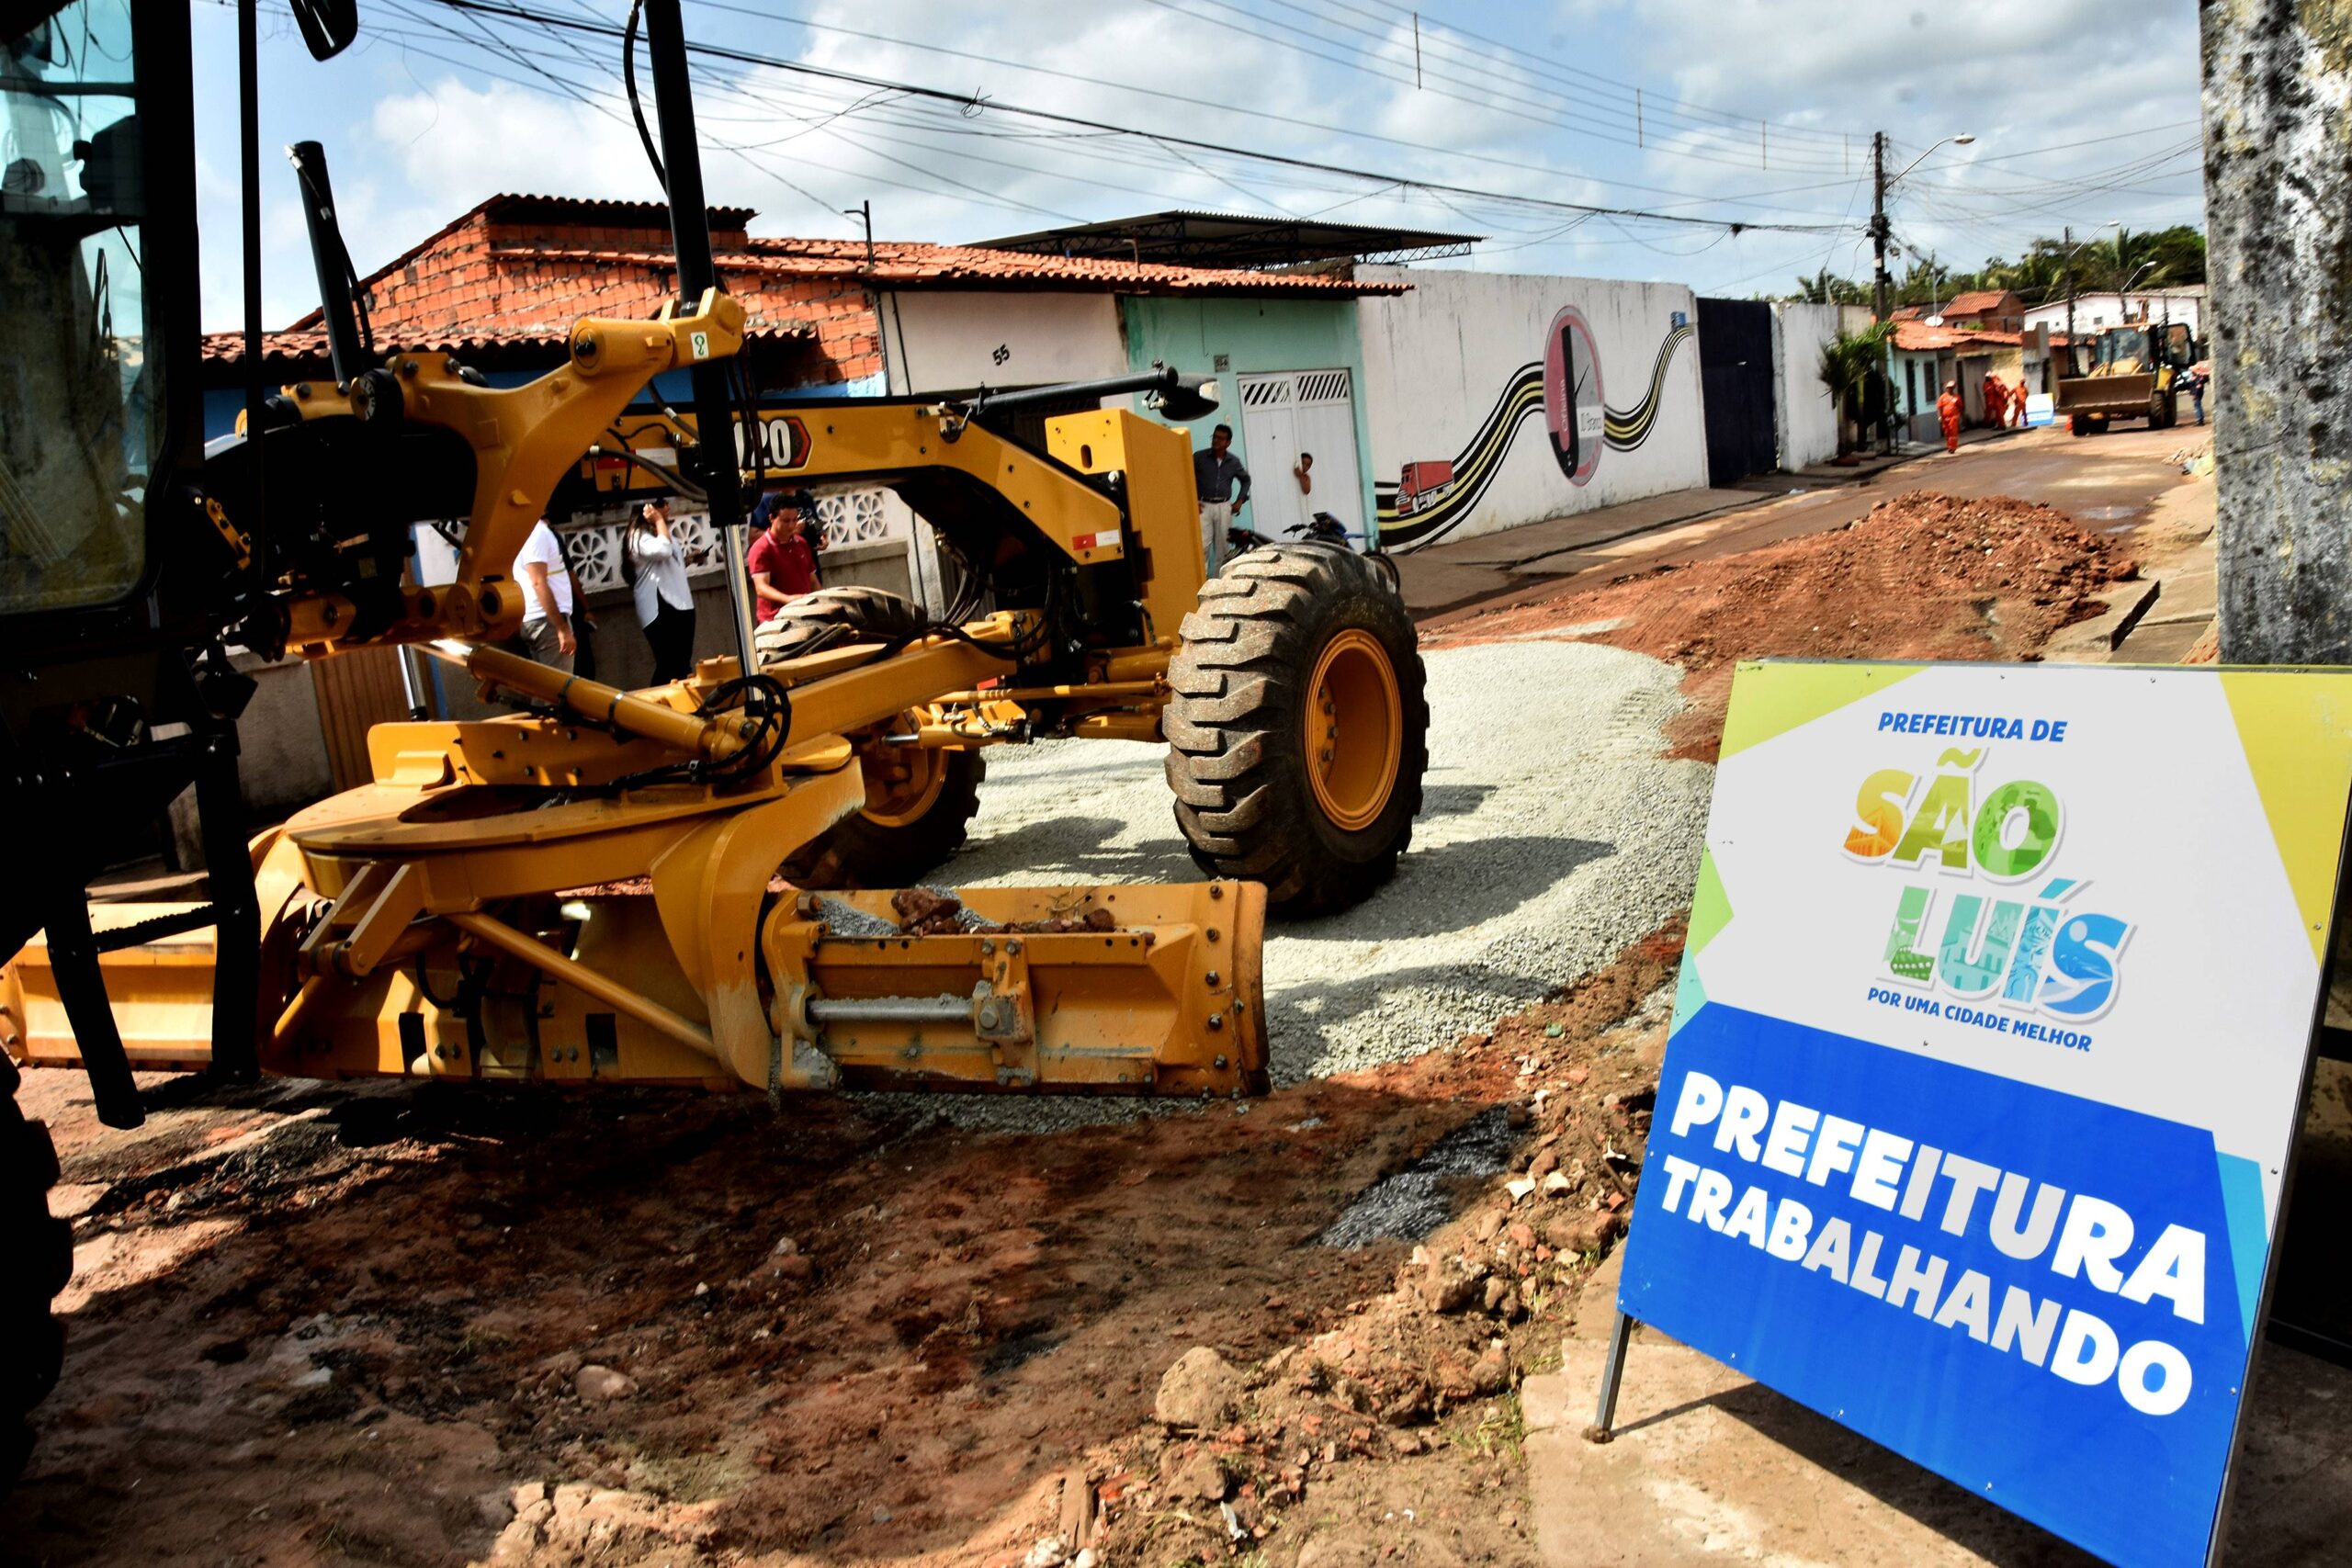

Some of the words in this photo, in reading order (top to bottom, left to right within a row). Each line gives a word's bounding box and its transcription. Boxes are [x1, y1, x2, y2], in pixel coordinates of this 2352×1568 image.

[992, 344, 1011, 367] 55
[1878, 712, 2023, 740] PREFEITURA
[2030, 719, 2068, 742] DE
[1843, 747, 2060, 877] SÃO
[1883, 878, 2129, 1015] LUÍS
[1867, 987, 1901, 1008] POR
[1905, 996, 1940, 1017] UMA
[1944, 1005, 2009, 1032] CIDADE
[2012, 1020, 2093, 1052] MELHOR
[1670, 1071, 2206, 1325] PREFEITURA
[1661, 1155, 2193, 1416] TRABALHANDO
